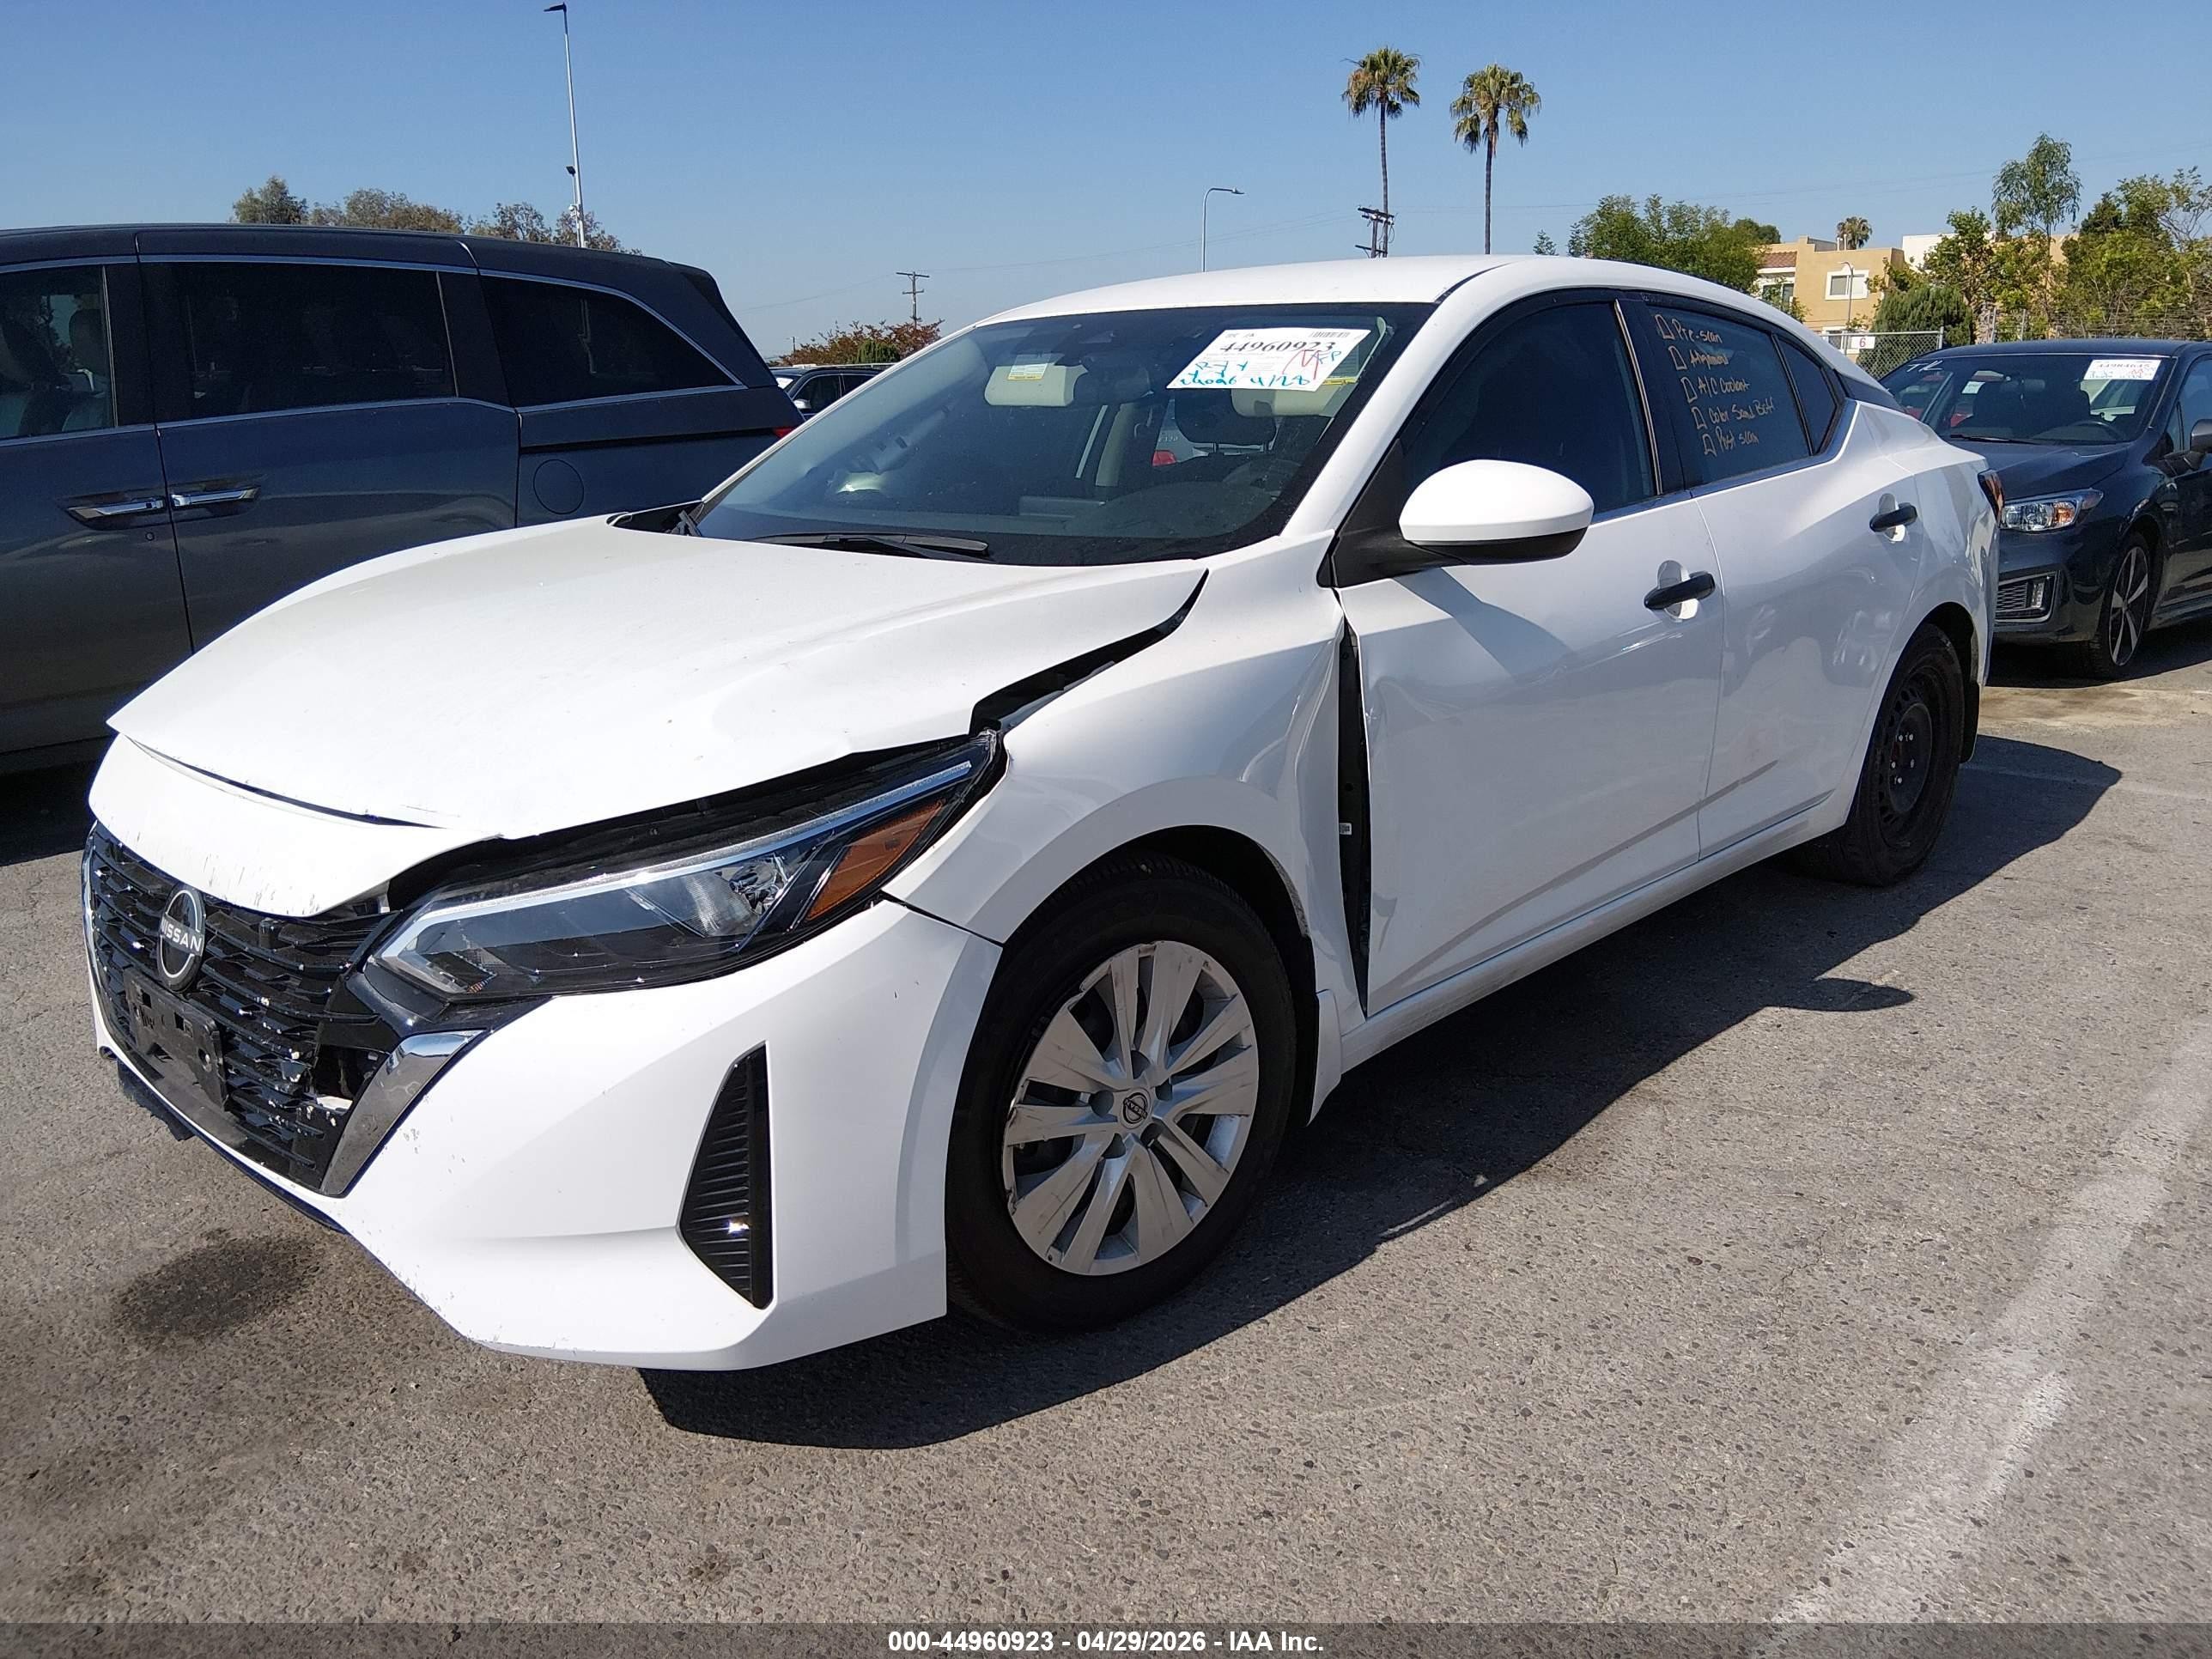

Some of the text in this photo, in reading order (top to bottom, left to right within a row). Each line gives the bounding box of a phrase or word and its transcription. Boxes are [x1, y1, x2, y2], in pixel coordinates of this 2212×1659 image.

[1220, 339, 1336, 353] 44960923
[1859, 337, 1866, 348] 6
[1697, 375, 1717, 398] A/C
[160, 916, 203, 952] NISSAN
